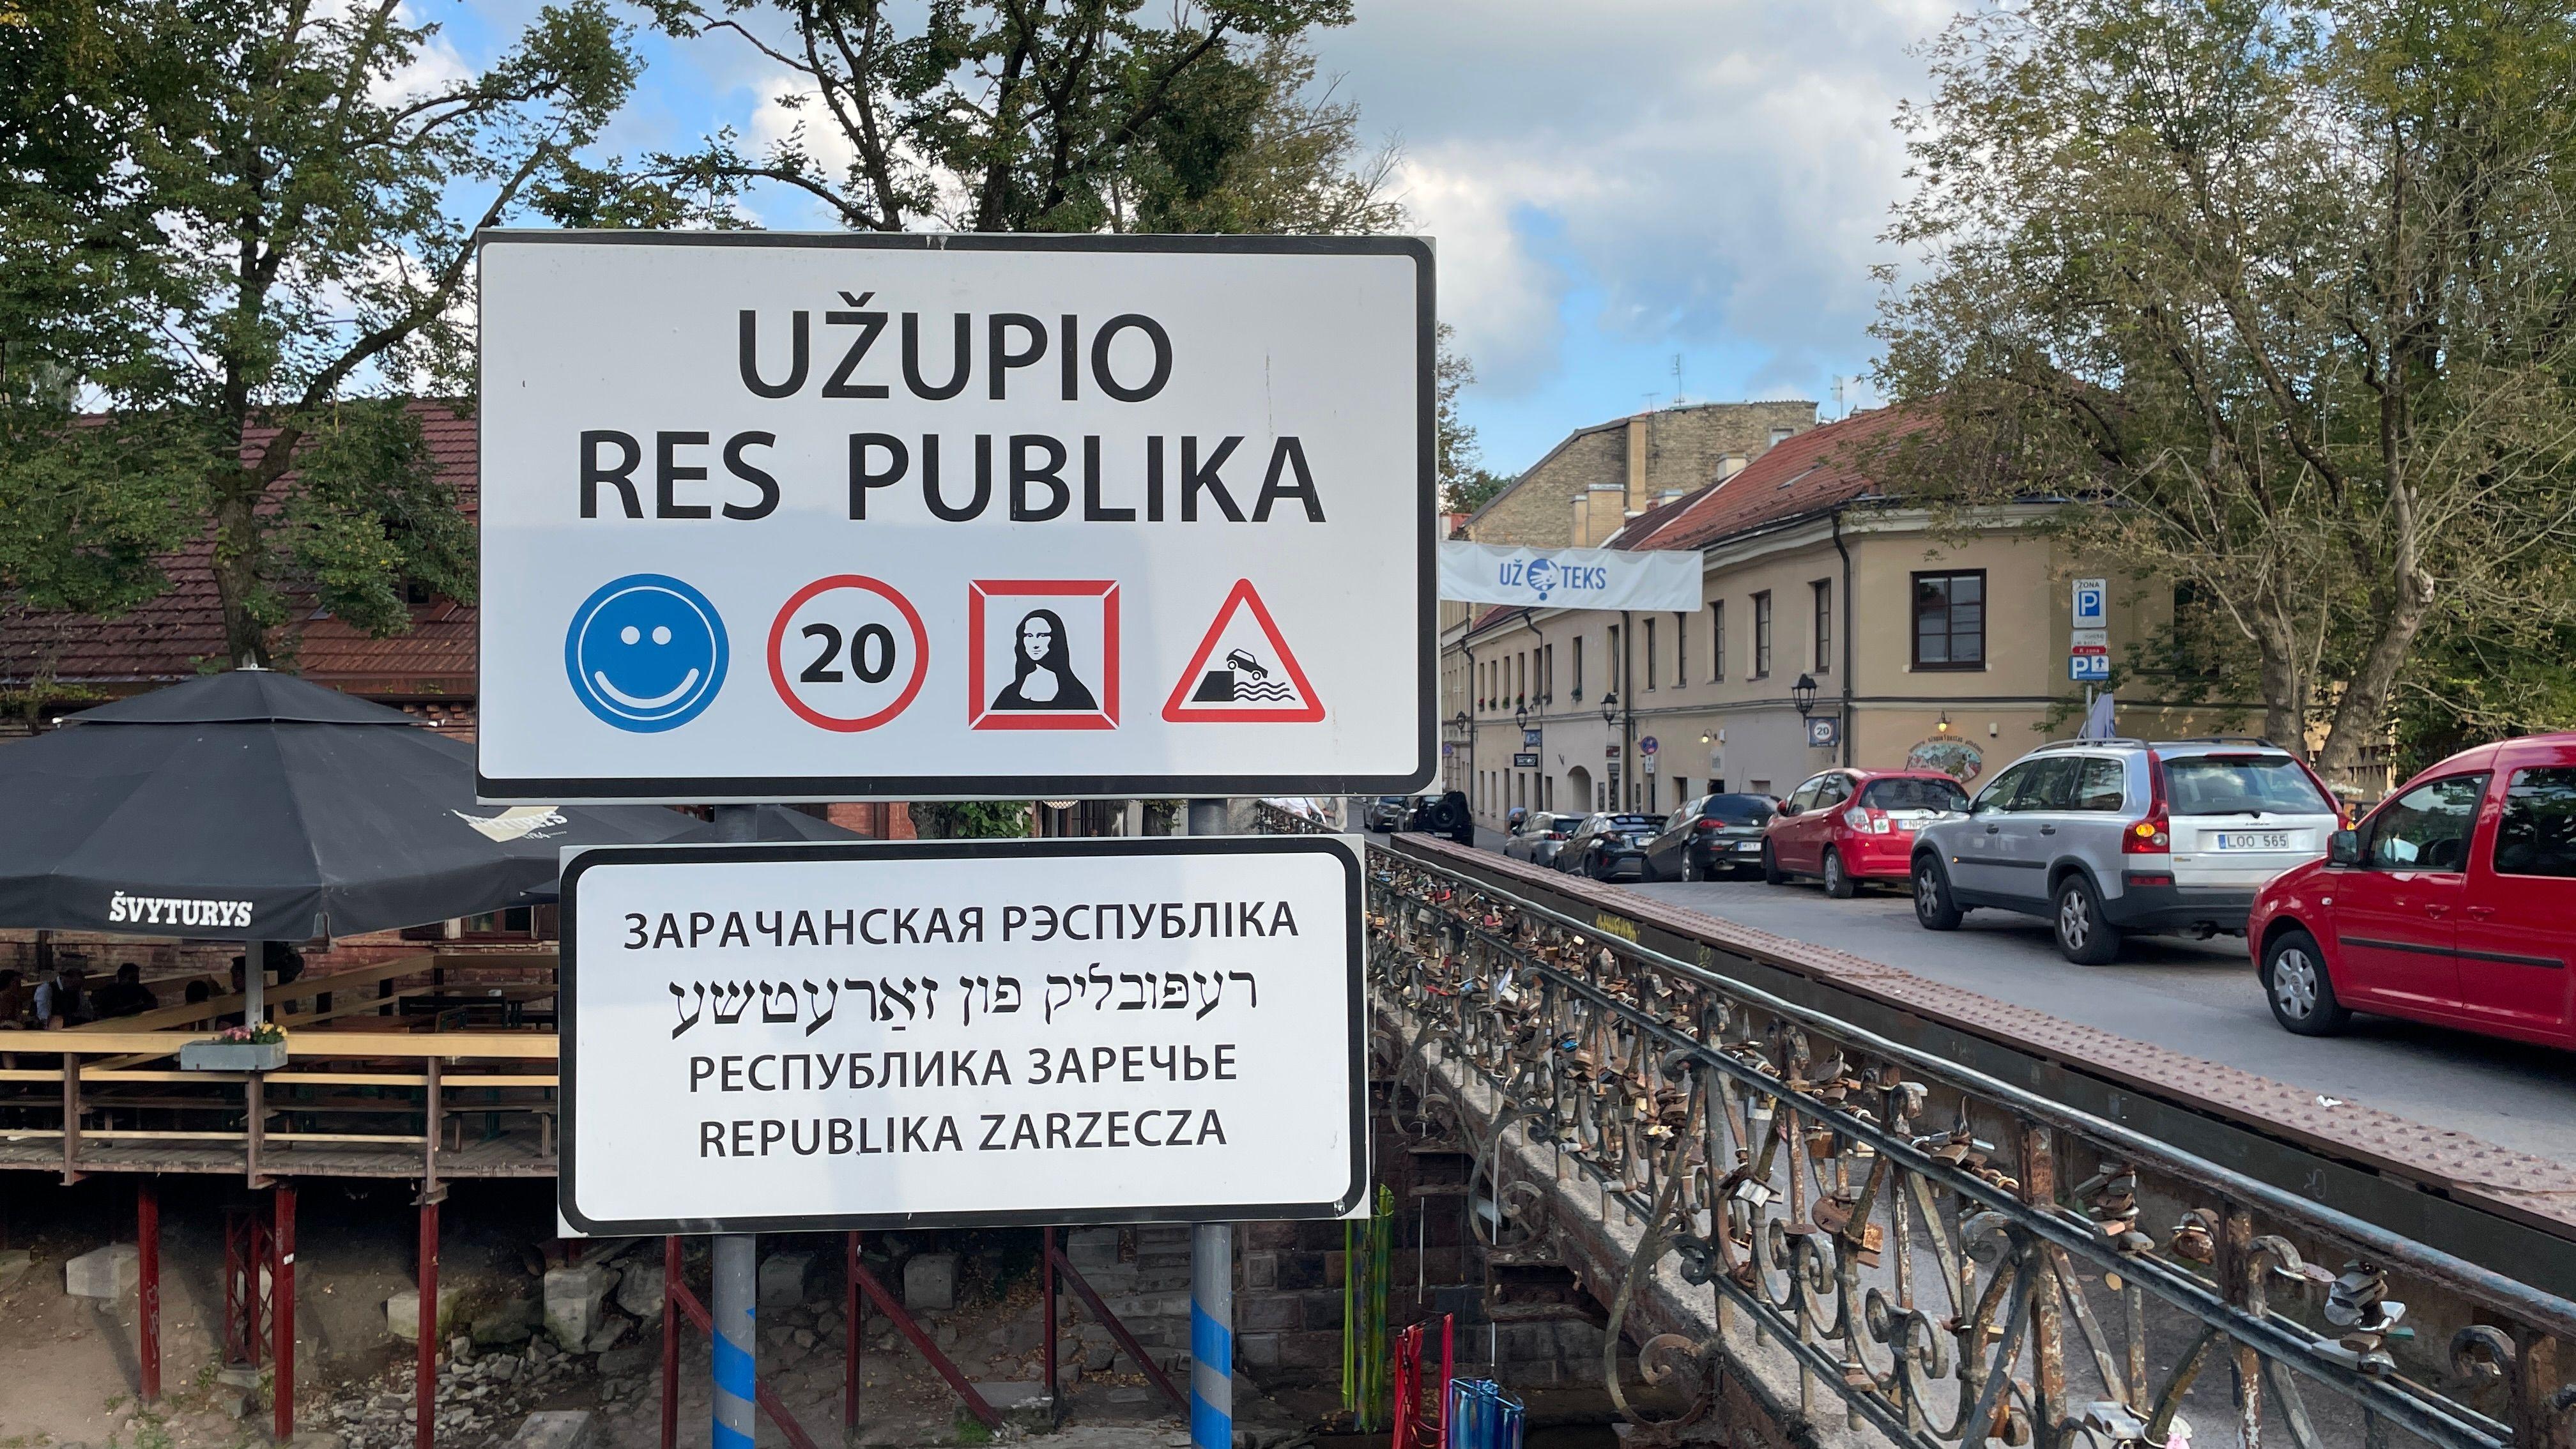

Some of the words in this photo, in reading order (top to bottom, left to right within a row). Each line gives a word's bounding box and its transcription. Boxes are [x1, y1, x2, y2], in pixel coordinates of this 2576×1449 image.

[739, 291, 1172, 402] UŽUPIO
[580, 430, 780, 521] RES
[849, 433, 1326, 523] PUBLIKA
[1561, 566, 1606, 590] TEKS
[2081, 592, 2098, 615] P
[800, 623, 896, 684] 20
[2072, 657, 2089, 679] P
[1816, 727, 1829, 735] 20
[2227, 836, 2255, 848] LOO
[2263, 836, 2287, 847] 565
[109, 891, 254, 928] ŠVYTURYS
[624, 907, 983, 949] ЗАРАЧАНСКАЯ
[1003, 901, 1299, 942] РЭСПУБЛІКА
[959, 974, 1021, 1027] פון
[690, 1049, 1012, 1092] РЕСПУБЛИКА
[1028, 1044, 1236, 1085] ЗАРЕЧЬЕ
[700, 1116, 963, 1157] REPUBLIKA
[979, 1109, 1227, 1151] ZARZECZA
